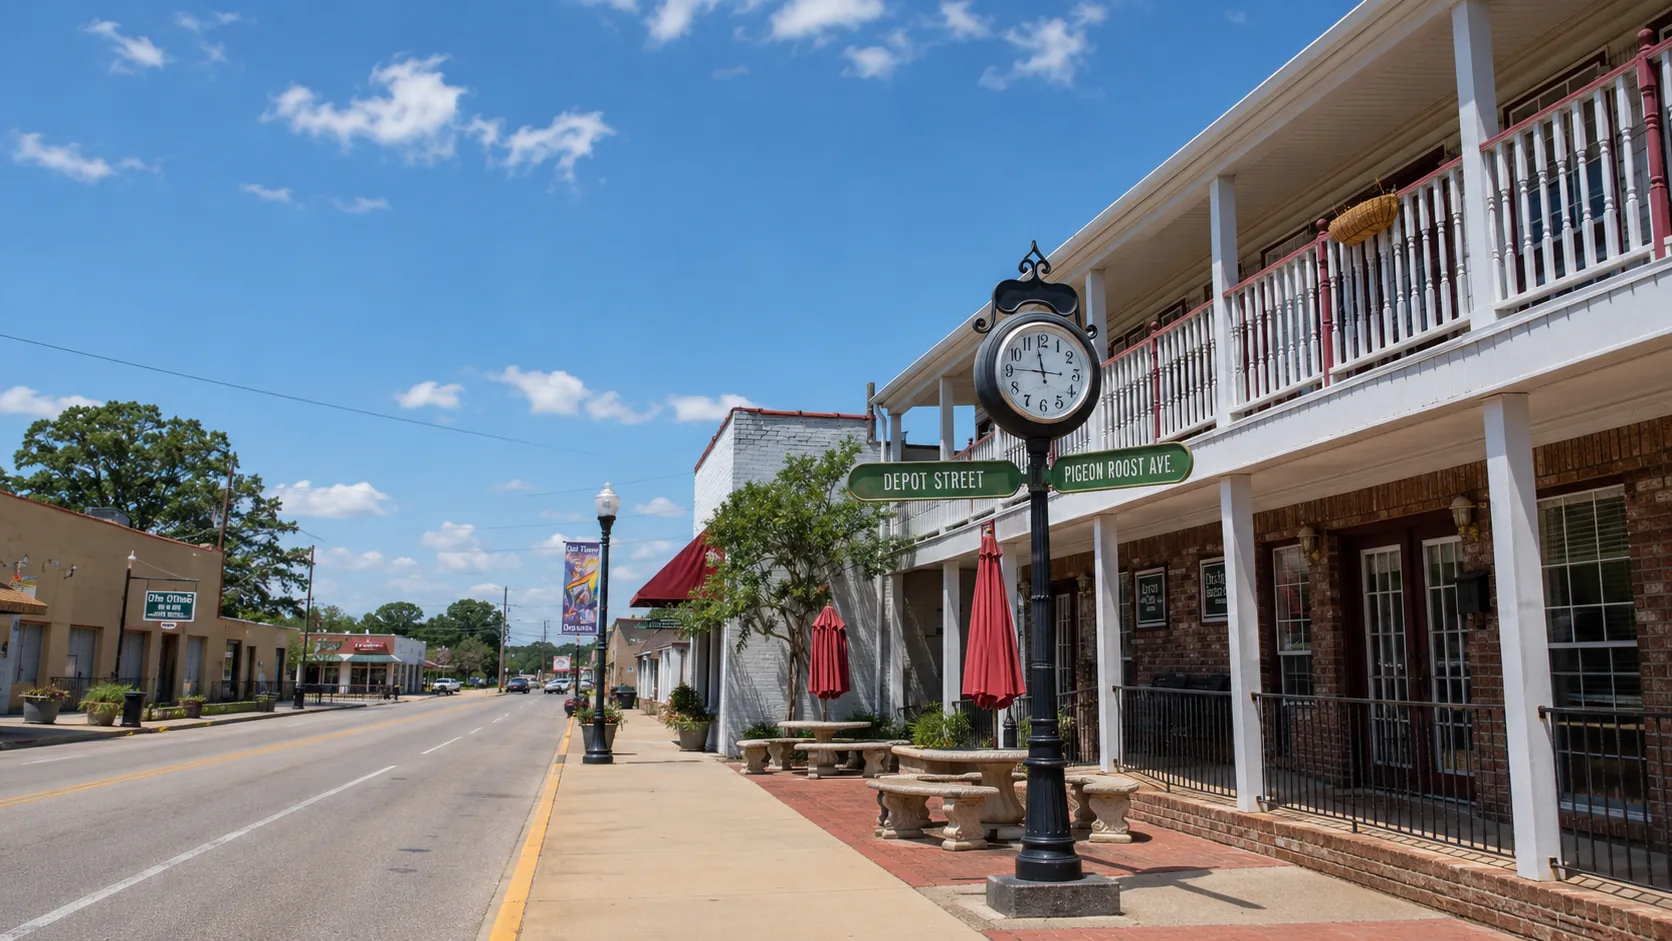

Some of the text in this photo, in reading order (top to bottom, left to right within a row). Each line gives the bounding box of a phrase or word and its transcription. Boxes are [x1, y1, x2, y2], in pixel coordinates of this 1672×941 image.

[1023, 336, 1031, 351] 11
[1037, 334, 1048, 348] 12
[1056, 339, 1060, 353] 1
[1011, 347, 1021, 362] 10
[1065, 351, 1073, 364] 2
[1005, 364, 1013, 377] 9
[1071, 368, 1080, 382] 3
[1011, 381, 1019, 395] 8
[1066, 384, 1076, 398] 4
[1023, 394, 1031, 407] 7
[1039, 399, 1047, 412] 6
[1054, 395, 1063, 409] 5
[1065, 454, 1175, 483] PIGEON ROOST AVE.
[884, 470, 984, 491] DEPOT STREET
